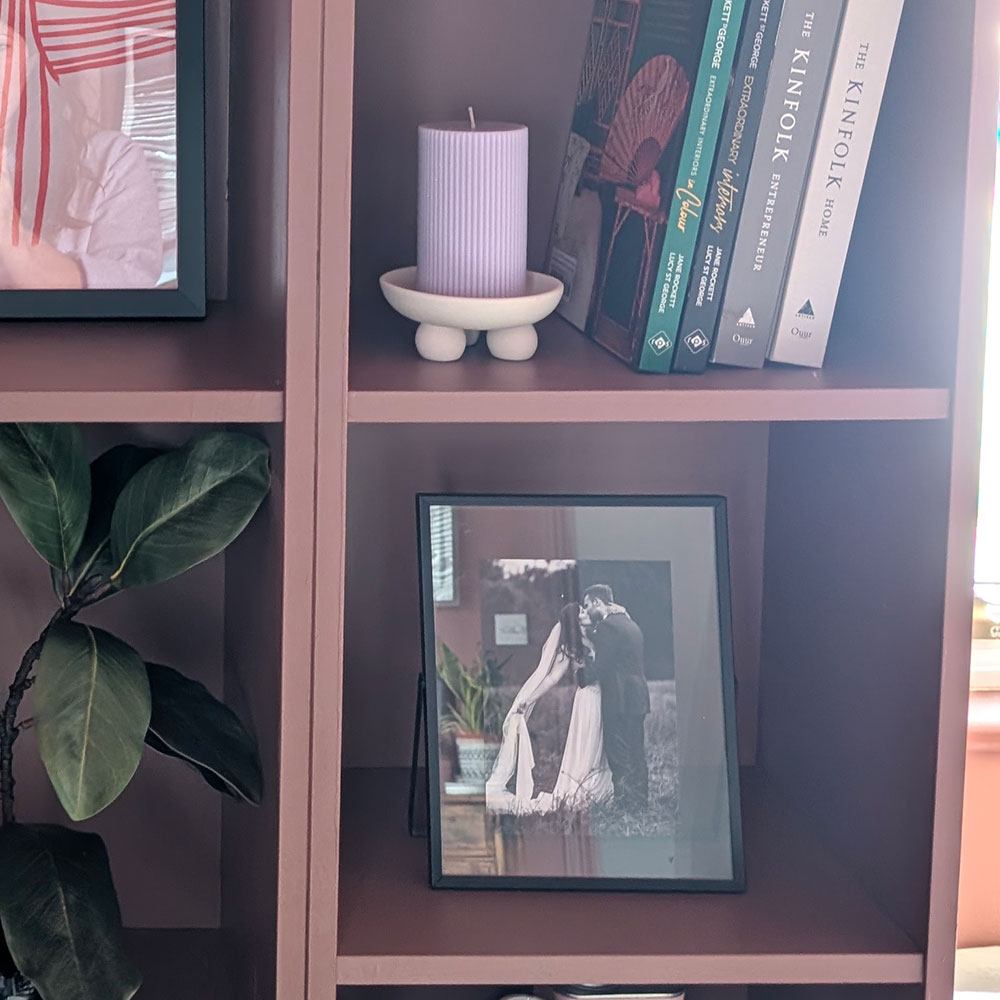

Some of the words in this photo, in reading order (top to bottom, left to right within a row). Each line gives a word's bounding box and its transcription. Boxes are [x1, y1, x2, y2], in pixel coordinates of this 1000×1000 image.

[801, 12, 815, 38] THE
[711, 28, 727, 69] GEORGE
[749, 31, 763, 69] GEORGE
[856, 43, 869, 70] THE
[699, 75, 717, 135] EXTRAORDINARY
[728, 75, 754, 165] EXTRAORDINARY
[771, 48, 811, 163] KINFOLK
[826, 79, 864, 189] KINFOLK
[690, 137, 704, 177] INTERIORS
[676, 187, 702, 234] Colour
[753, 173, 781, 272] ENTREPRENEUR
[818, 199, 835, 237] HOME
[665, 252, 676, 274] LUCY
[675, 253, 684, 274] JANE
[703, 245, 713, 266] LUCY
[712, 246, 722, 267] JANE
[664, 275, 671, 283] ST
[668, 274, 681, 309] ROCKETT
[696, 275, 708, 307] GEORGE
[706, 267, 718, 301] ROCKETT
[658, 283, 670, 314] GEORGE
